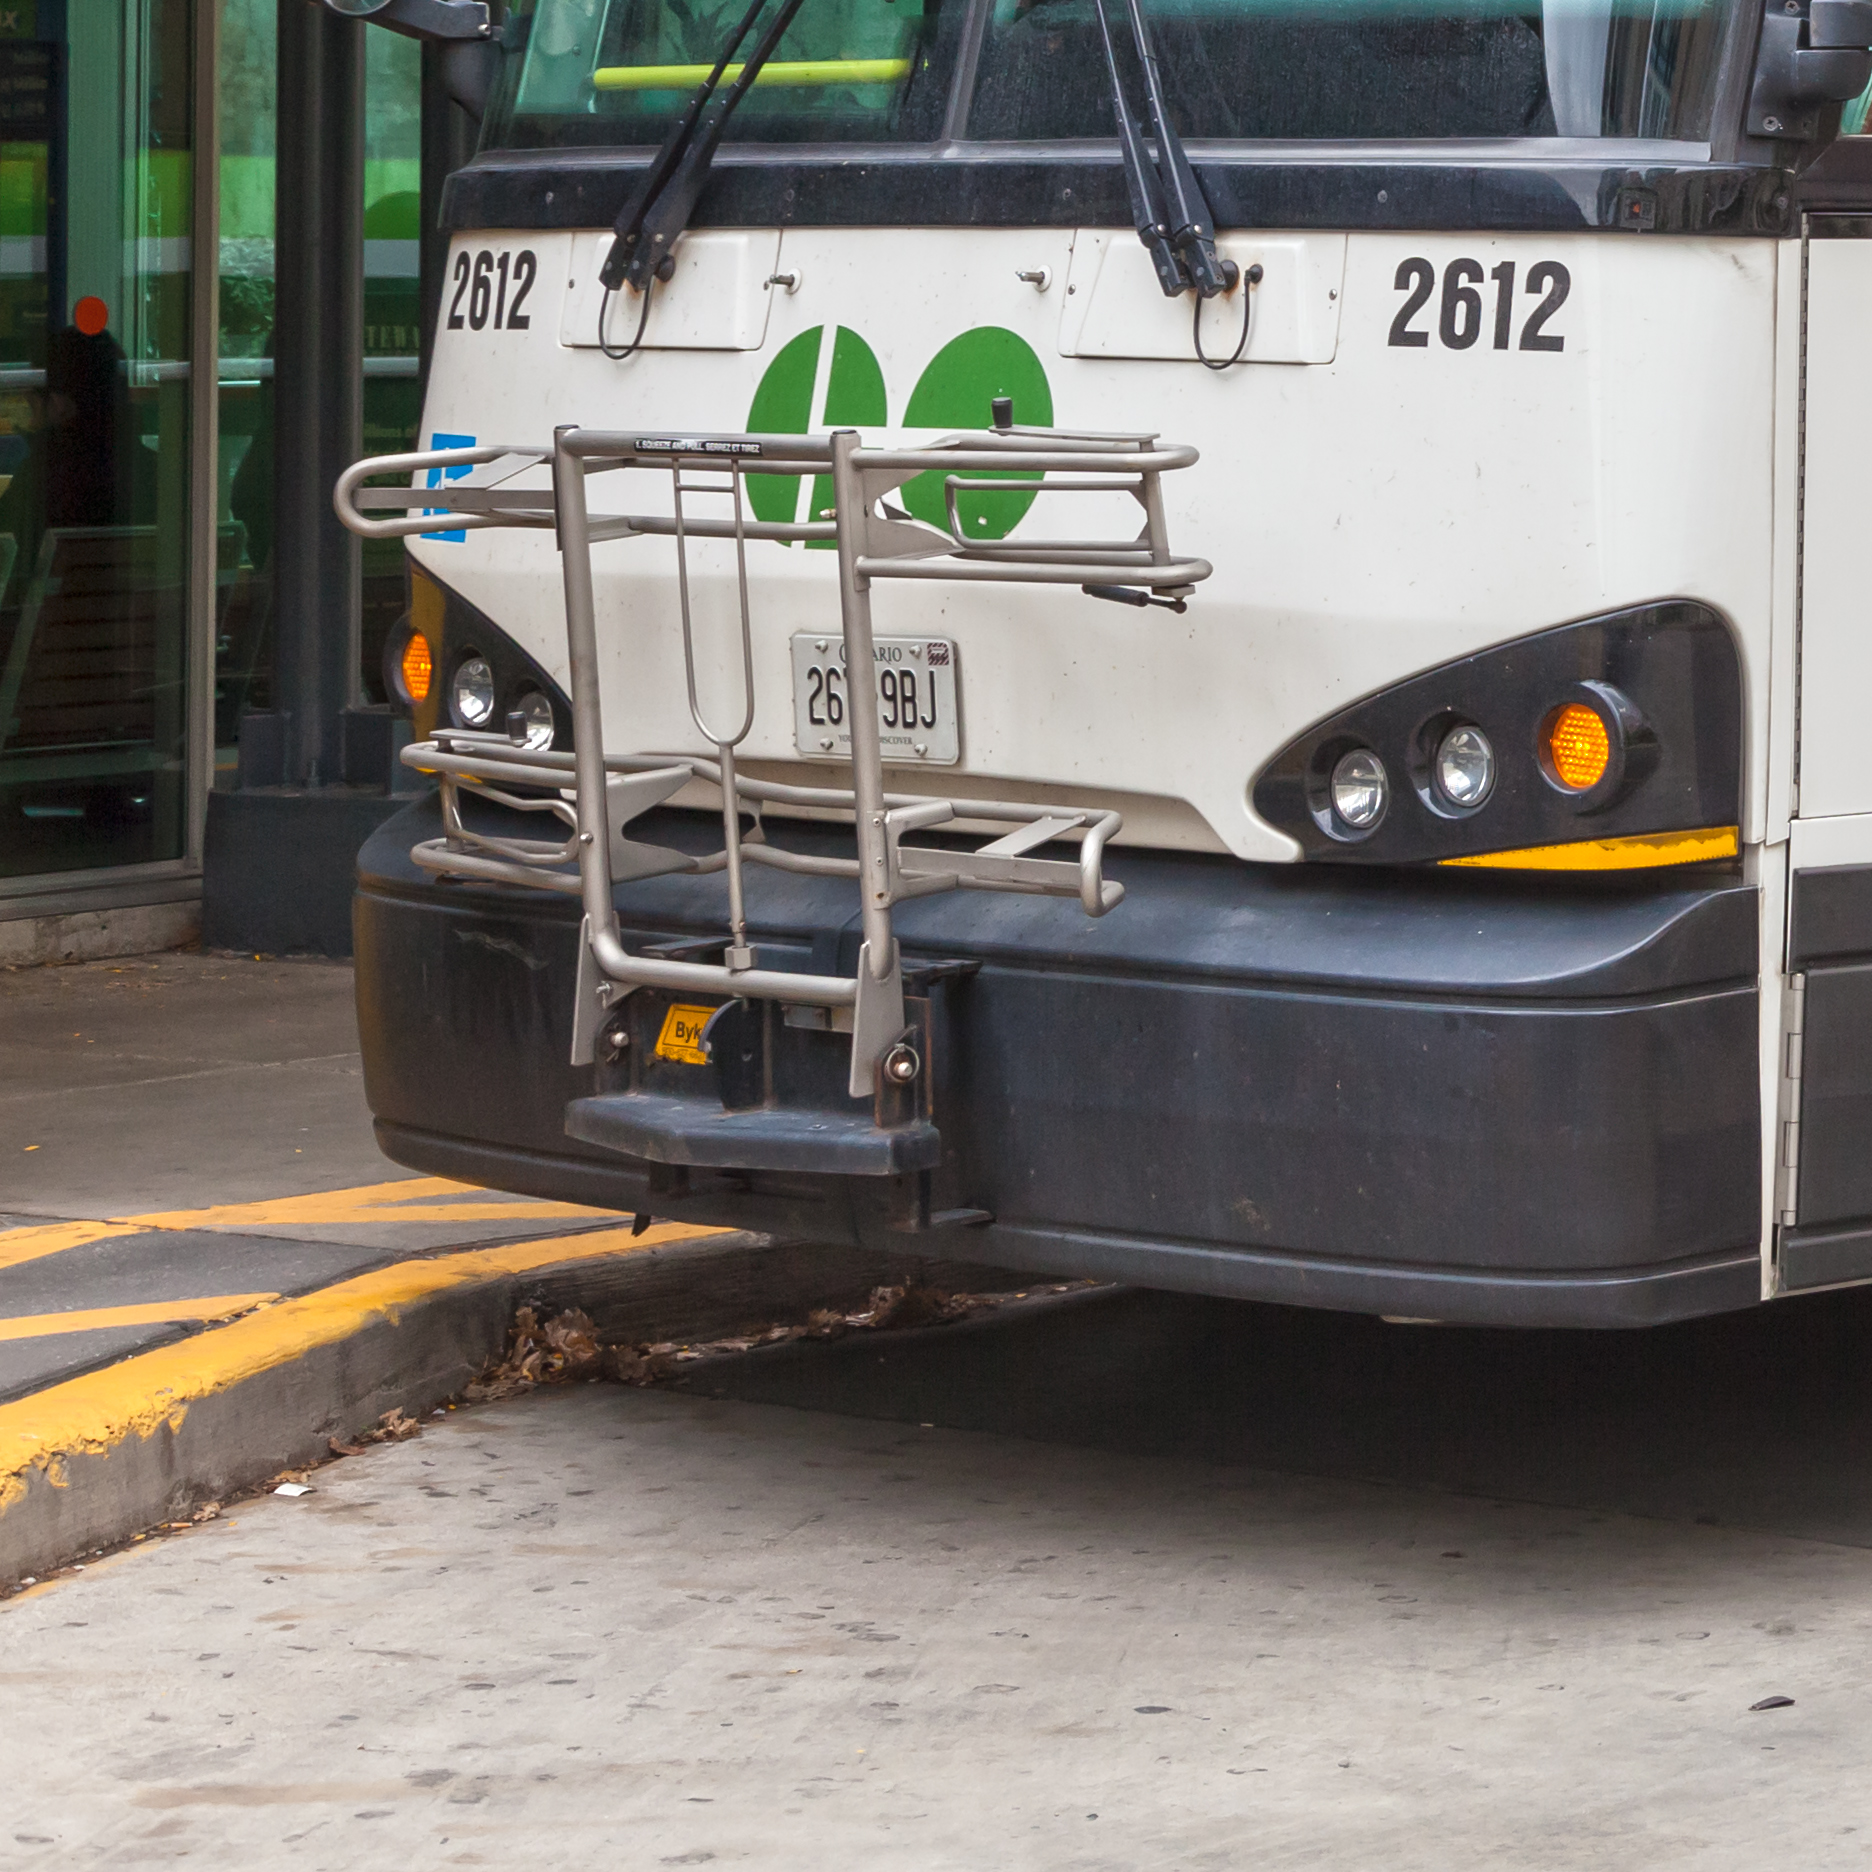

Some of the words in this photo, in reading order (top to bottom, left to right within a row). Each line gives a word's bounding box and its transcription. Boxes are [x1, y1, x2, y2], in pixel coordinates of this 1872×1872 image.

[447, 249, 538, 331] 2612
[1387, 256, 1571, 352] 2612
[675, 1020, 704, 1044] Byk
